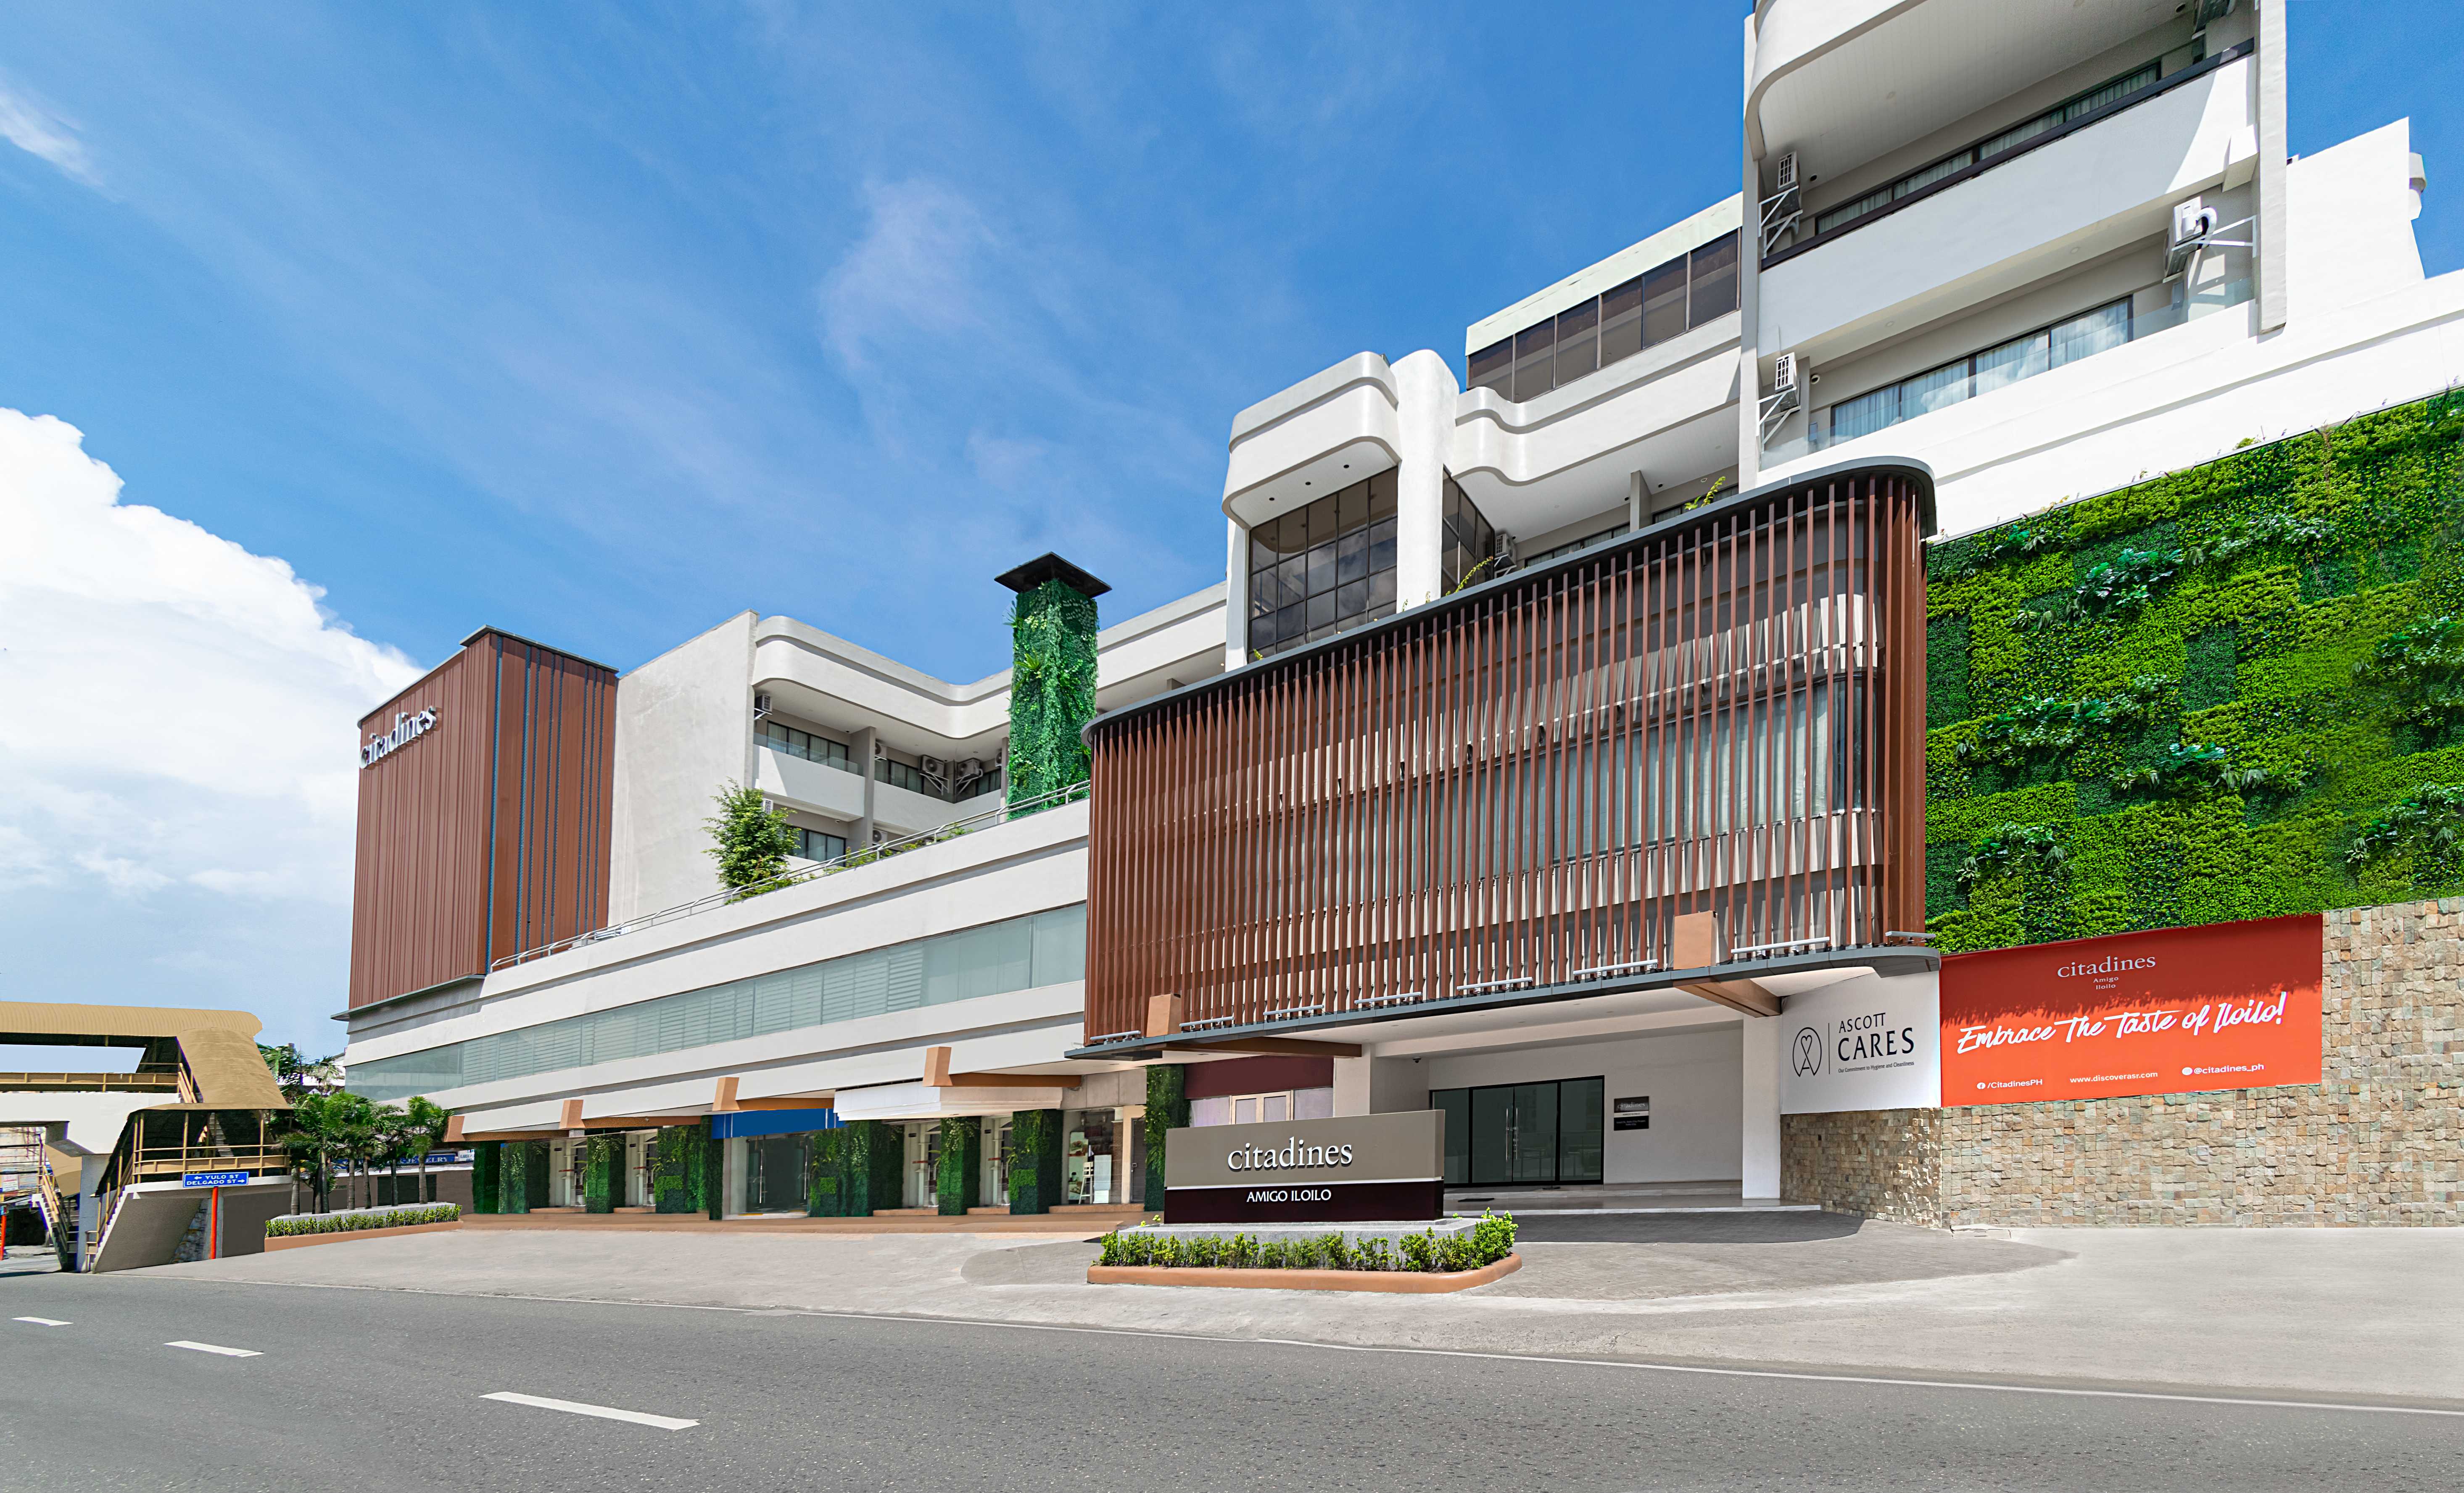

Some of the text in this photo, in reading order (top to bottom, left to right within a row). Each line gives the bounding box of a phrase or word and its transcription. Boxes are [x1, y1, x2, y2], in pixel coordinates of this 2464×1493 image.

[2057, 956, 2156, 977] citadines
[1839, 1012, 1886, 1033] ASCOTT
[1957, 991, 2287, 1054] Embrace The Taste of Iloilo!
[1838, 1027, 1914, 1061] CARES
[2070, 1072, 2158, 1083] www.discoverasr.com
[2194, 1064, 2264, 1074] @citadines_ph
[1987, 1079, 2043, 1089] /CitadinesPH
[1227, 1136, 1353, 1169] citadines
[1246, 1189, 1332, 1202] AMIGO ILOILO
